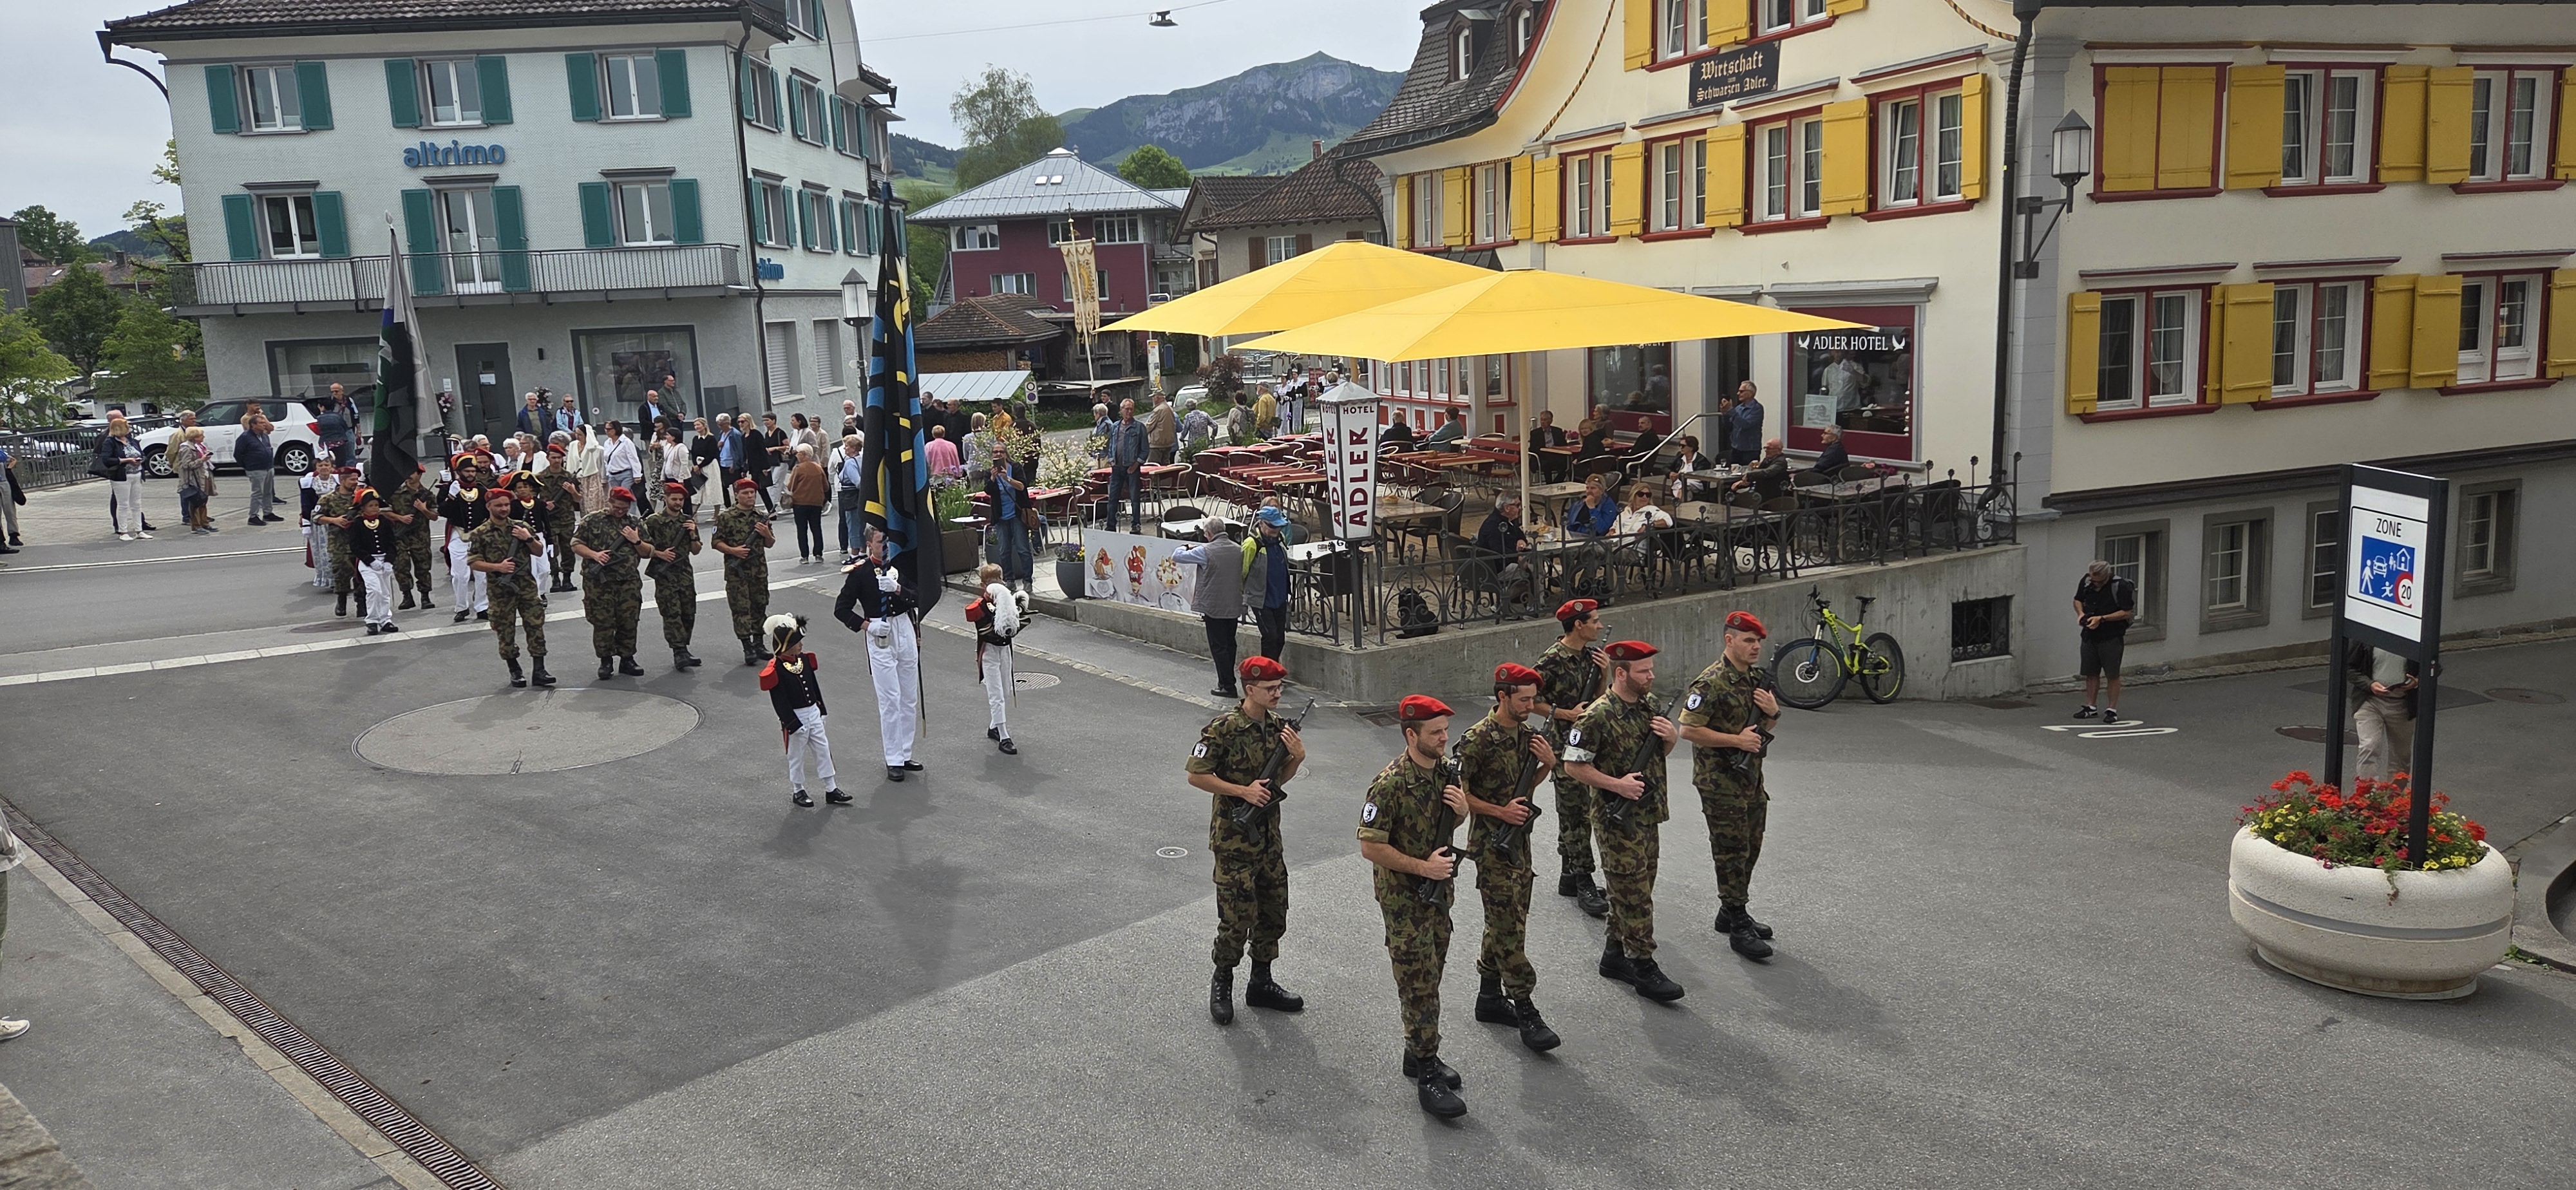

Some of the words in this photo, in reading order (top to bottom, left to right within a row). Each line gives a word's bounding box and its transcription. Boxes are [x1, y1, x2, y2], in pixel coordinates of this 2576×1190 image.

[1700, 50, 1763, 81] Wirtschaft
[1696, 82, 1740, 103] Schwarzen
[403, 139, 506, 168] altrimo
[1813, 335, 1848, 350] ADLER
[1850, 336, 1888, 350] HOTEL
[1343, 406, 1374, 415] HOTEL
[1327, 428, 1342, 527] ADLER
[1349, 427, 1368, 527] ADLER
[2376, 518, 2402, 537] ZONE
[2401, 585, 2412, 600] 20
